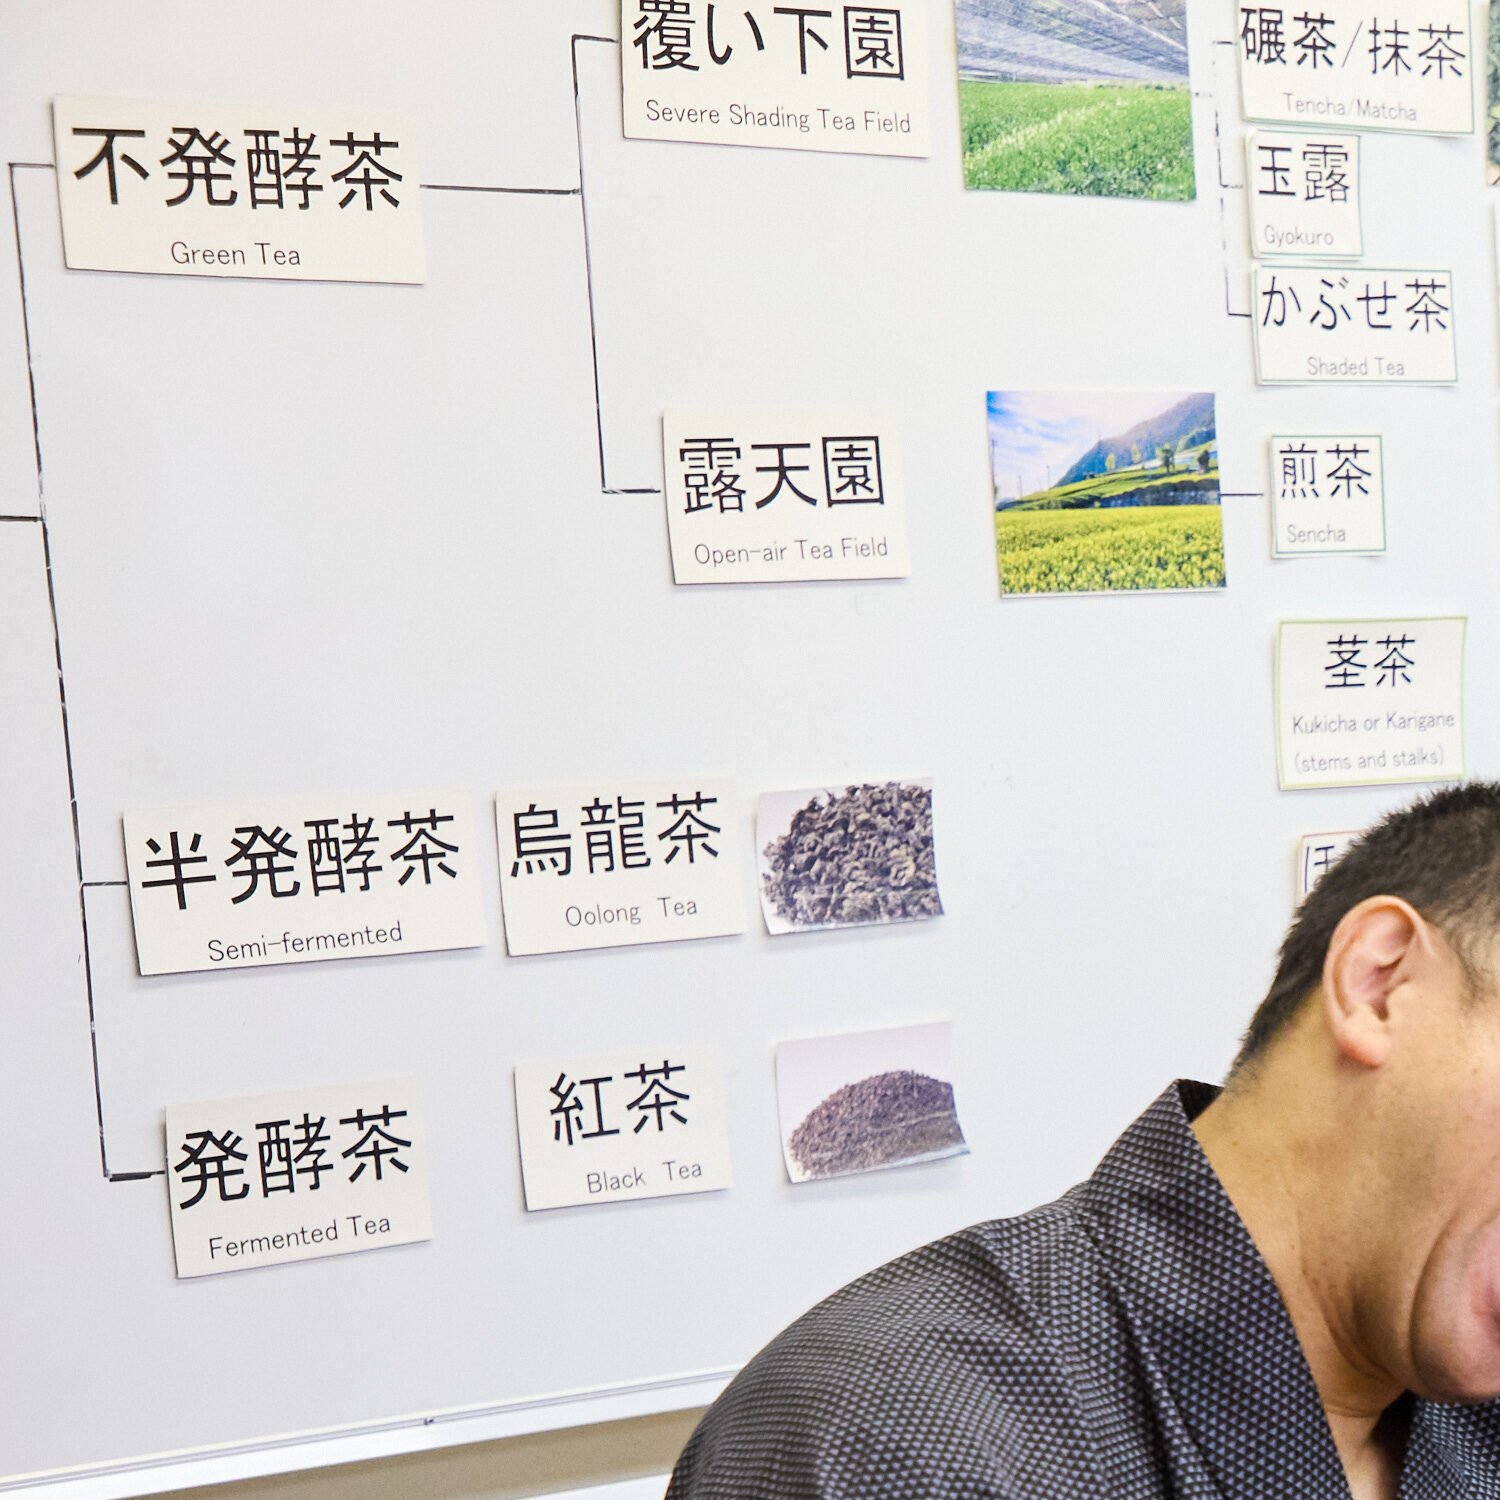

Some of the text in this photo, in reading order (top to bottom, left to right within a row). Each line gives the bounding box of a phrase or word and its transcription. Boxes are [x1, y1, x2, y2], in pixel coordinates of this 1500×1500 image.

[632, 0, 905, 81] 覆い下園
[646, 99, 911, 134] Severe Shading Tea Field
[1282, 92, 1418, 121] Tencha/Matcha
[71, 126, 403, 212] 不発酵茶
[1257, 143, 1350, 203] 玉露
[170, 241, 301, 266] Green Tea
[1264, 224, 1335, 248] Gyokuro
[1261, 275, 1449, 333] かぶせ茶
[1306, 355, 1406, 378] Shaded Tea
[679, 435, 885, 515] 露天園
[1279, 442, 1372, 499] 煎茶
[694, 536, 888, 568] Open-air Tea Field
[1286, 523, 1347, 544] Sencha
[1324, 633, 1416, 689] 茎茶
[1292, 711, 1455, 735] Kukicha or Karigane
[1294, 745, 1444, 774] (stems and stalks)
[510, 791, 721, 878] 烏龍茶
[141, 808, 460, 911] 半発酵茶
[565, 896, 698, 928] Oolong Tea
[207, 921, 404, 963] Semi-fermented
[549, 1059, 690, 1146] 紅茶
[173, 1104, 412, 1211] 発酵茶
[586, 1160, 703, 1194] Black Tea
[208, 1214, 391, 1260] Fermented Tea
